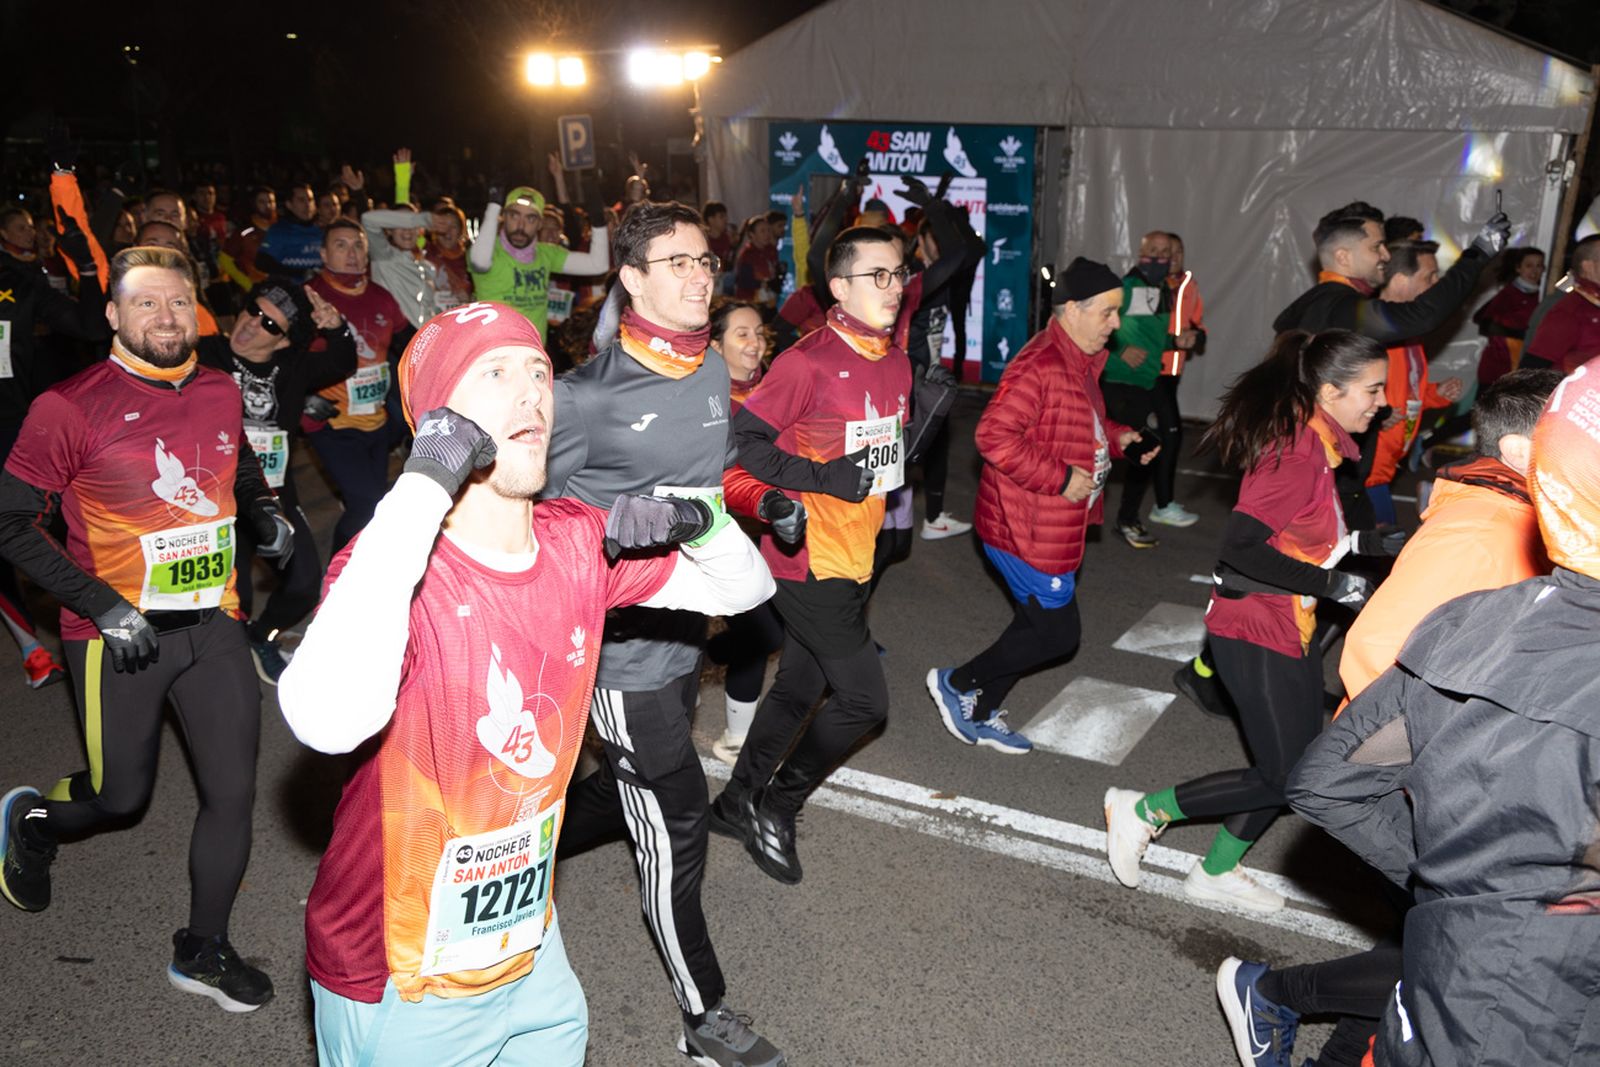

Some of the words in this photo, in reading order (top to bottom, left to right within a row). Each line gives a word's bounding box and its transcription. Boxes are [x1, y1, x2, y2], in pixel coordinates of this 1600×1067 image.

[568, 122, 586, 163] P
[866, 131, 890, 152] 43
[890, 131, 931, 152] SAN
[174, 485, 199, 506] 43
[168, 535, 197, 549] NOCHE
[199, 533, 209, 544] DE
[159, 550, 179, 563] SAN
[168, 552, 224, 586] 1933
[501, 724, 535, 764] 43
[456, 845, 474, 864] 43
[475, 840, 517, 863] NOCHE
[518, 834, 532, 851] DE
[453, 866, 486, 884] SAN
[487, 851, 530, 879] ANTÓN
[461, 858, 548, 925] 12727
[471, 919, 513, 936] Francisco
[513, 908, 537, 925] Javier
